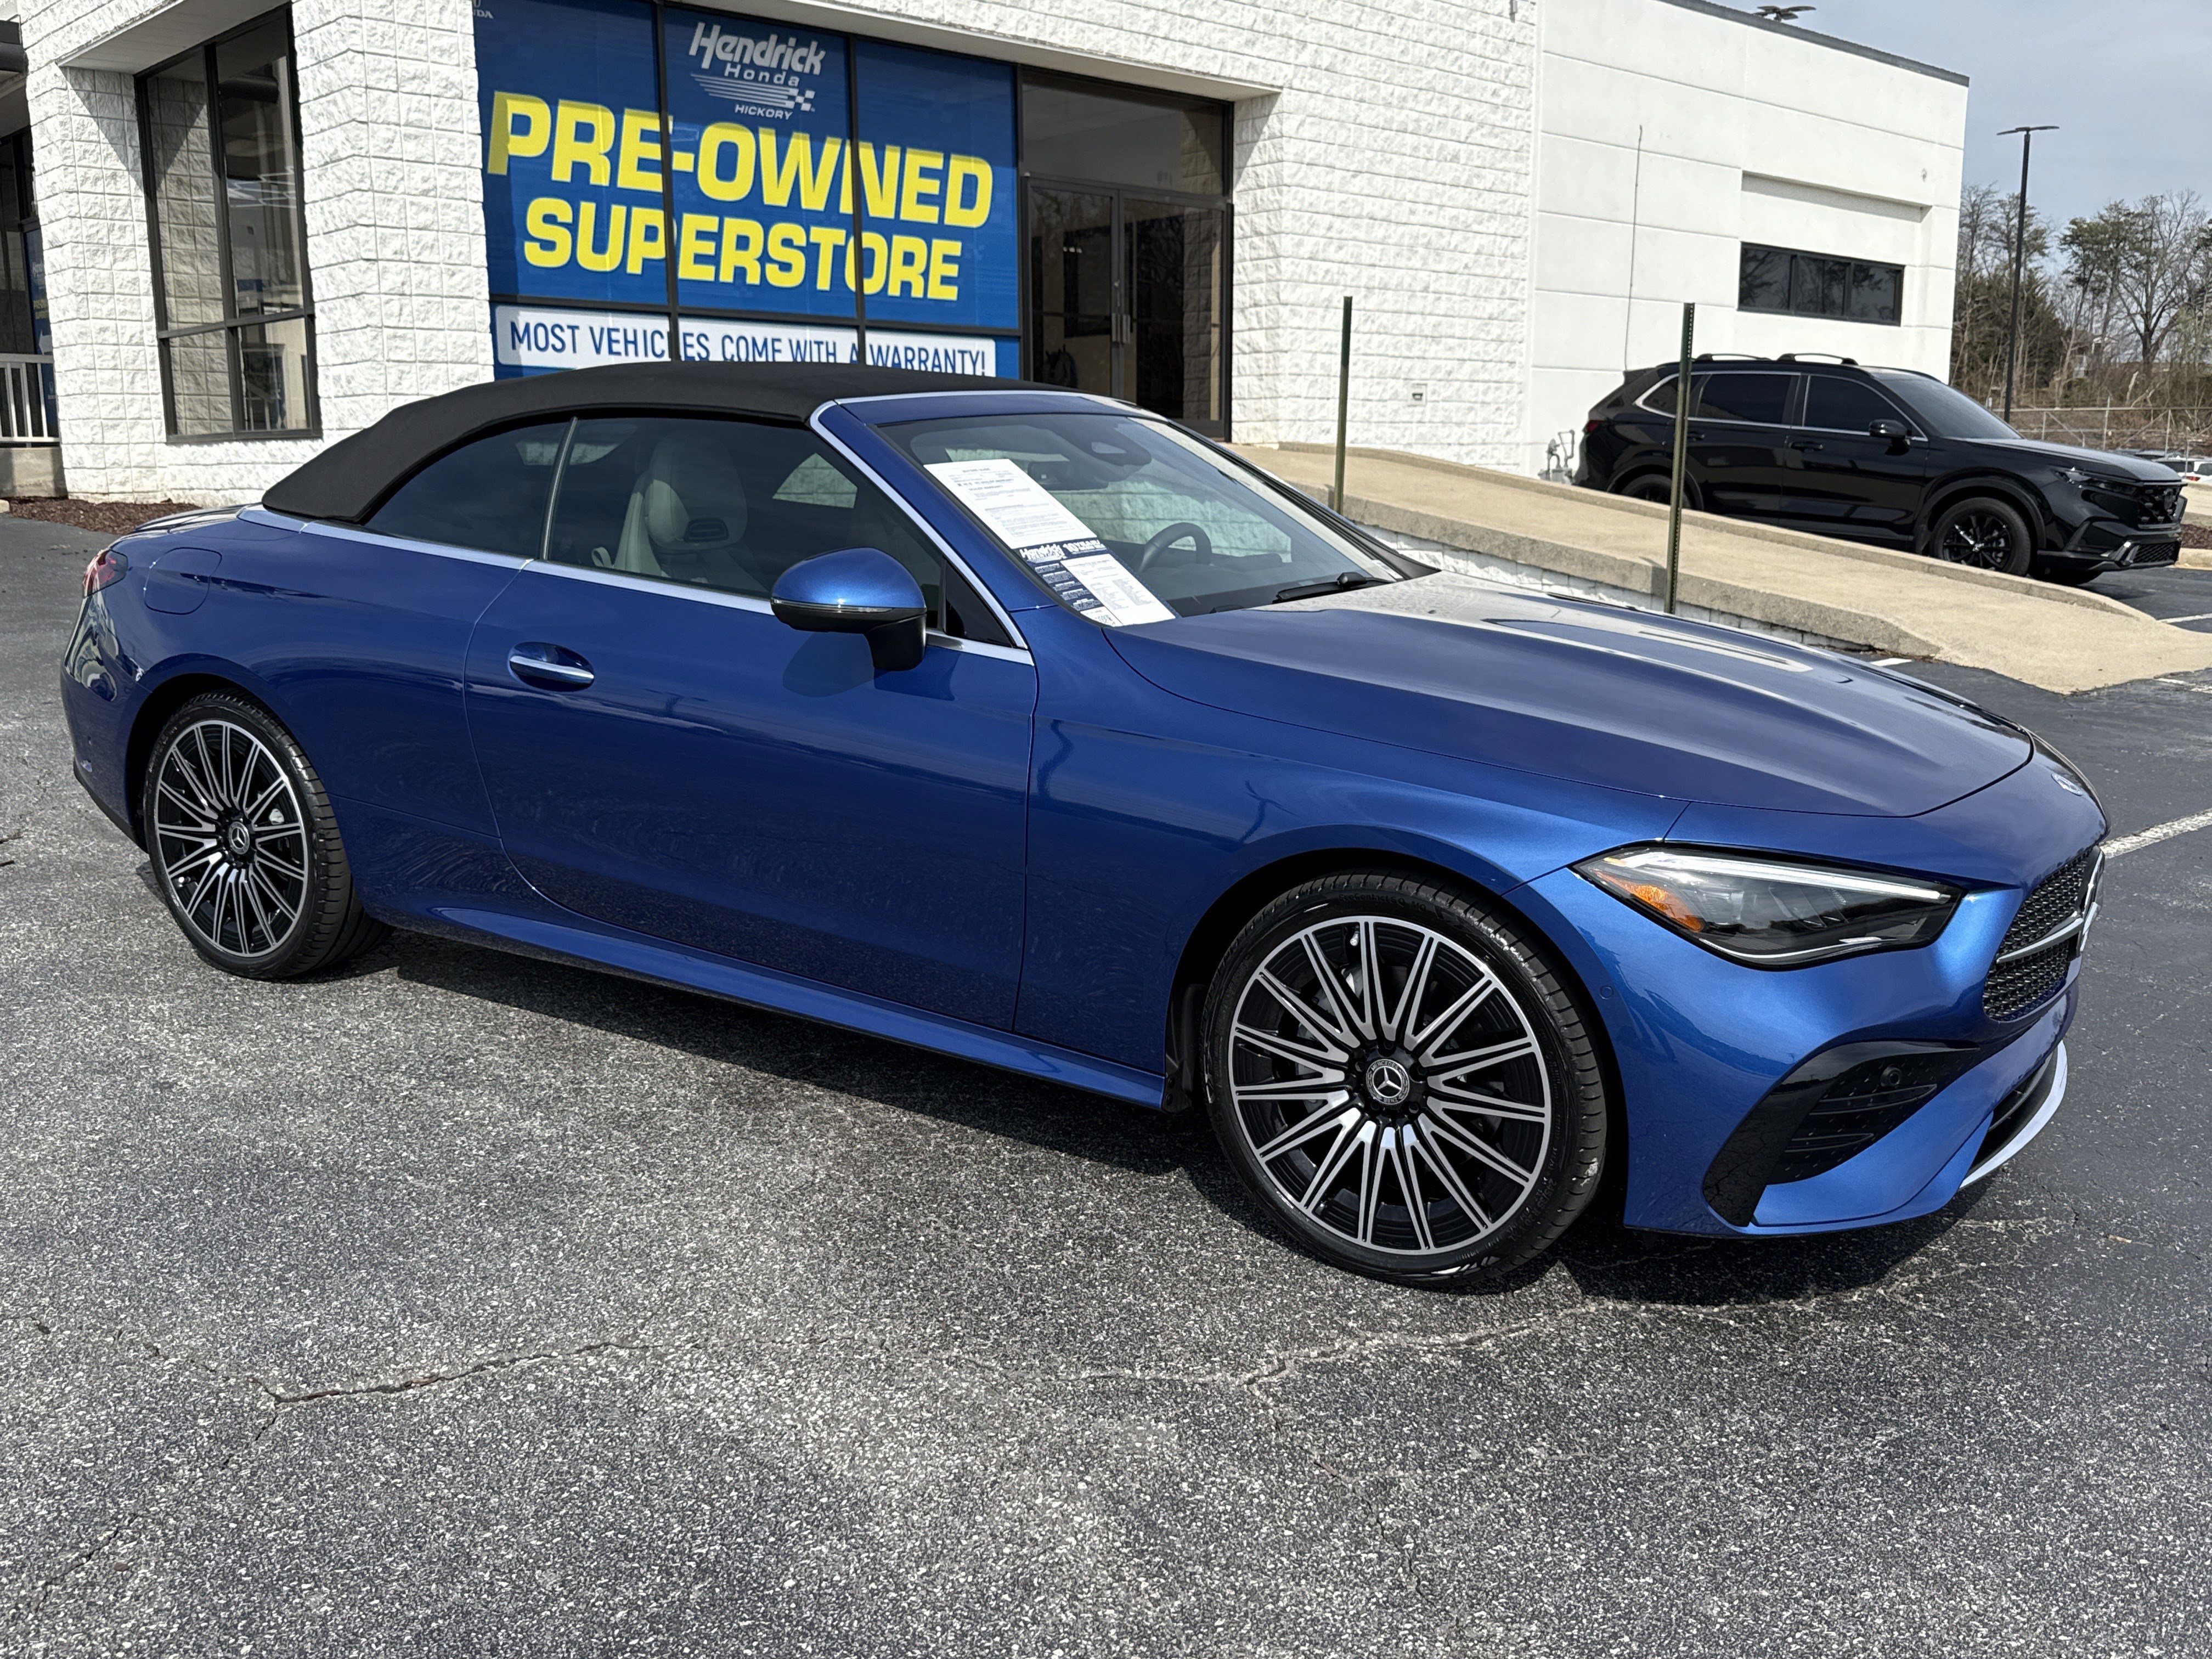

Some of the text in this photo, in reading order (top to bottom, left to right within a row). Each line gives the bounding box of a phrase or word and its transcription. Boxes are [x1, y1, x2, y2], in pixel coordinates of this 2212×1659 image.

[689, 22, 826, 75] Hendrick
[724, 63, 800, 87] Honda
[735, 104, 793, 120] HICKORY
[487, 90, 993, 228] PRE-OWNED
[524, 198, 962, 301] SUPERSTORE
[511, 321, 579, 354] MOST
[589, 326, 710, 361] VEHICES
[788, 338, 837, 363] WITH
[869, 343, 985, 376] WARRANTY!
